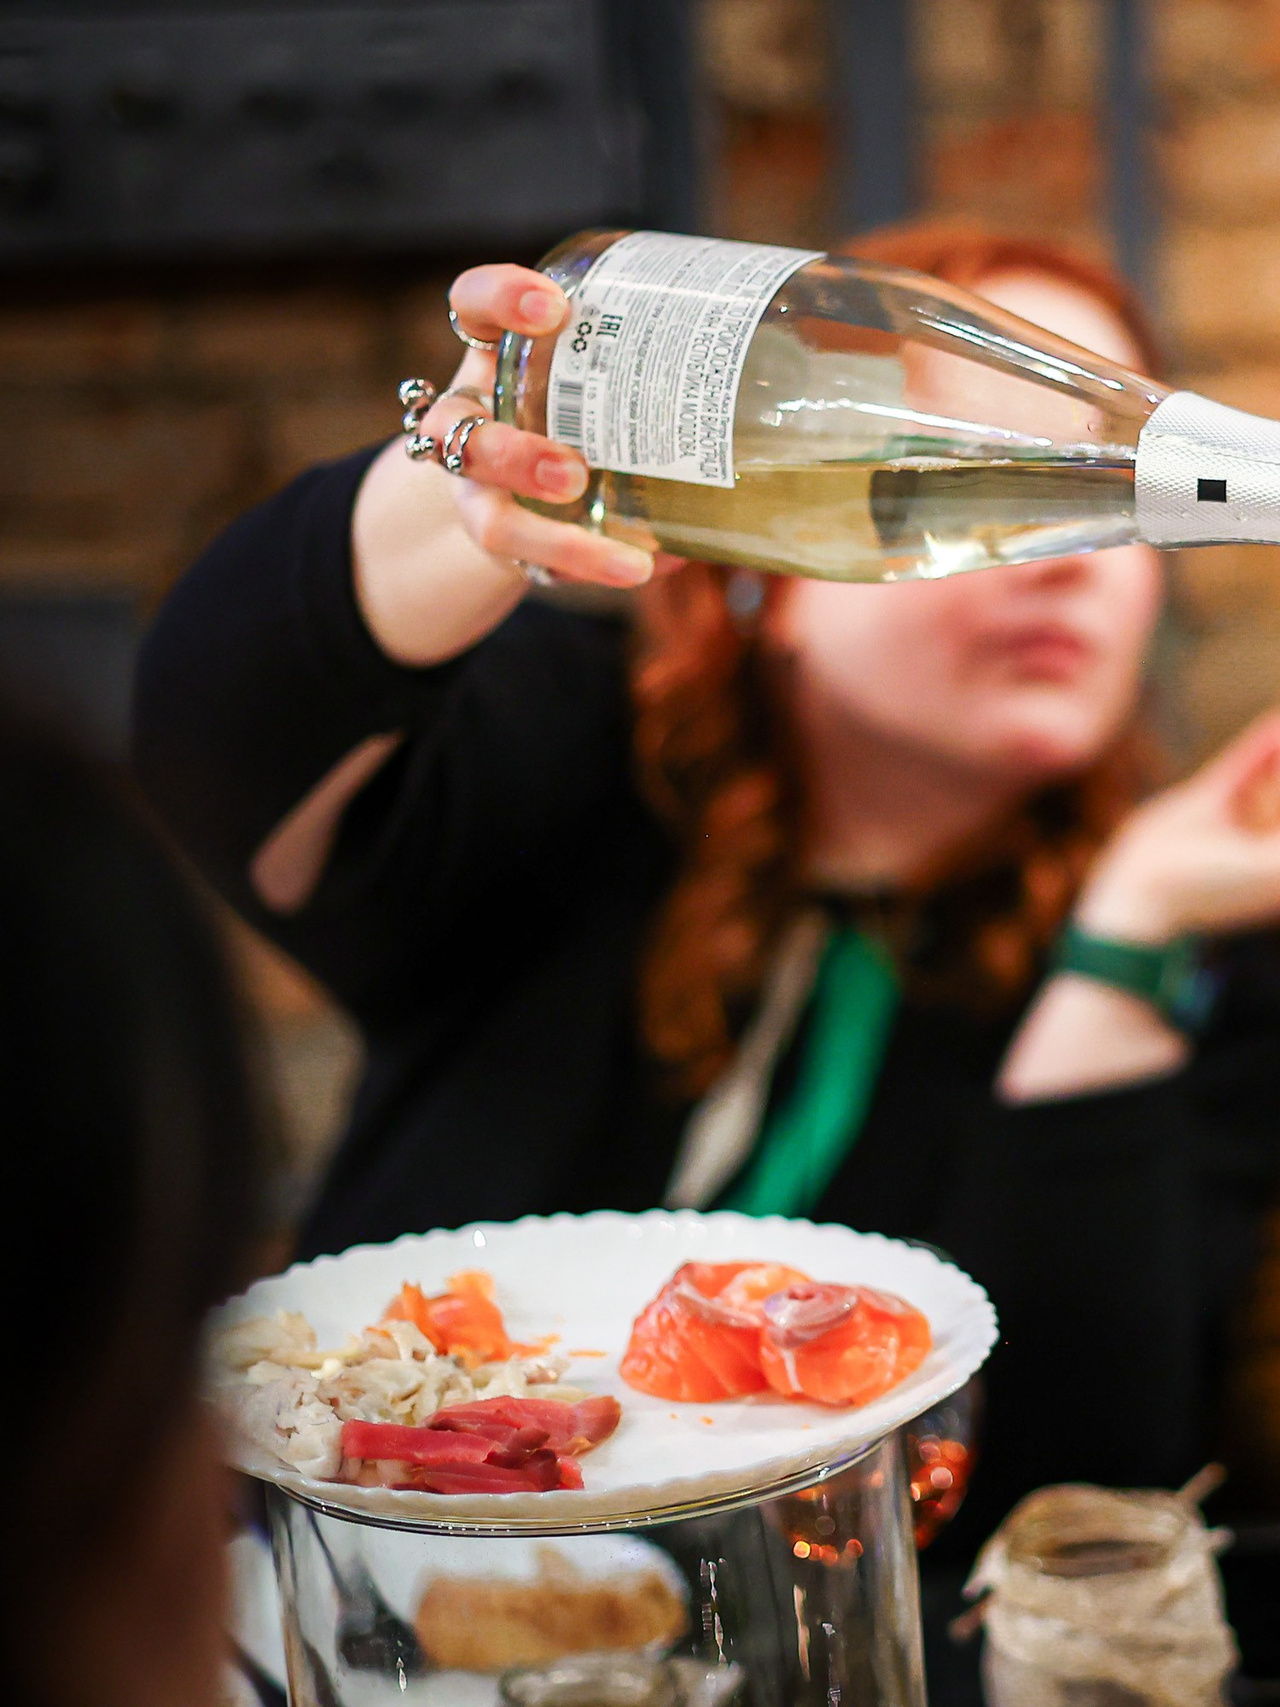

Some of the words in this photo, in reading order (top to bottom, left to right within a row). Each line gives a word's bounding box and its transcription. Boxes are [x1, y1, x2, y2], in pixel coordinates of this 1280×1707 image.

[682, 332, 714, 399] РЕСПУБЛИКА
[701, 318, 742, 414] ПРОИСХОЖДЕНИЯ
[699, 415, 720, 479] ВИНОГРАДА
